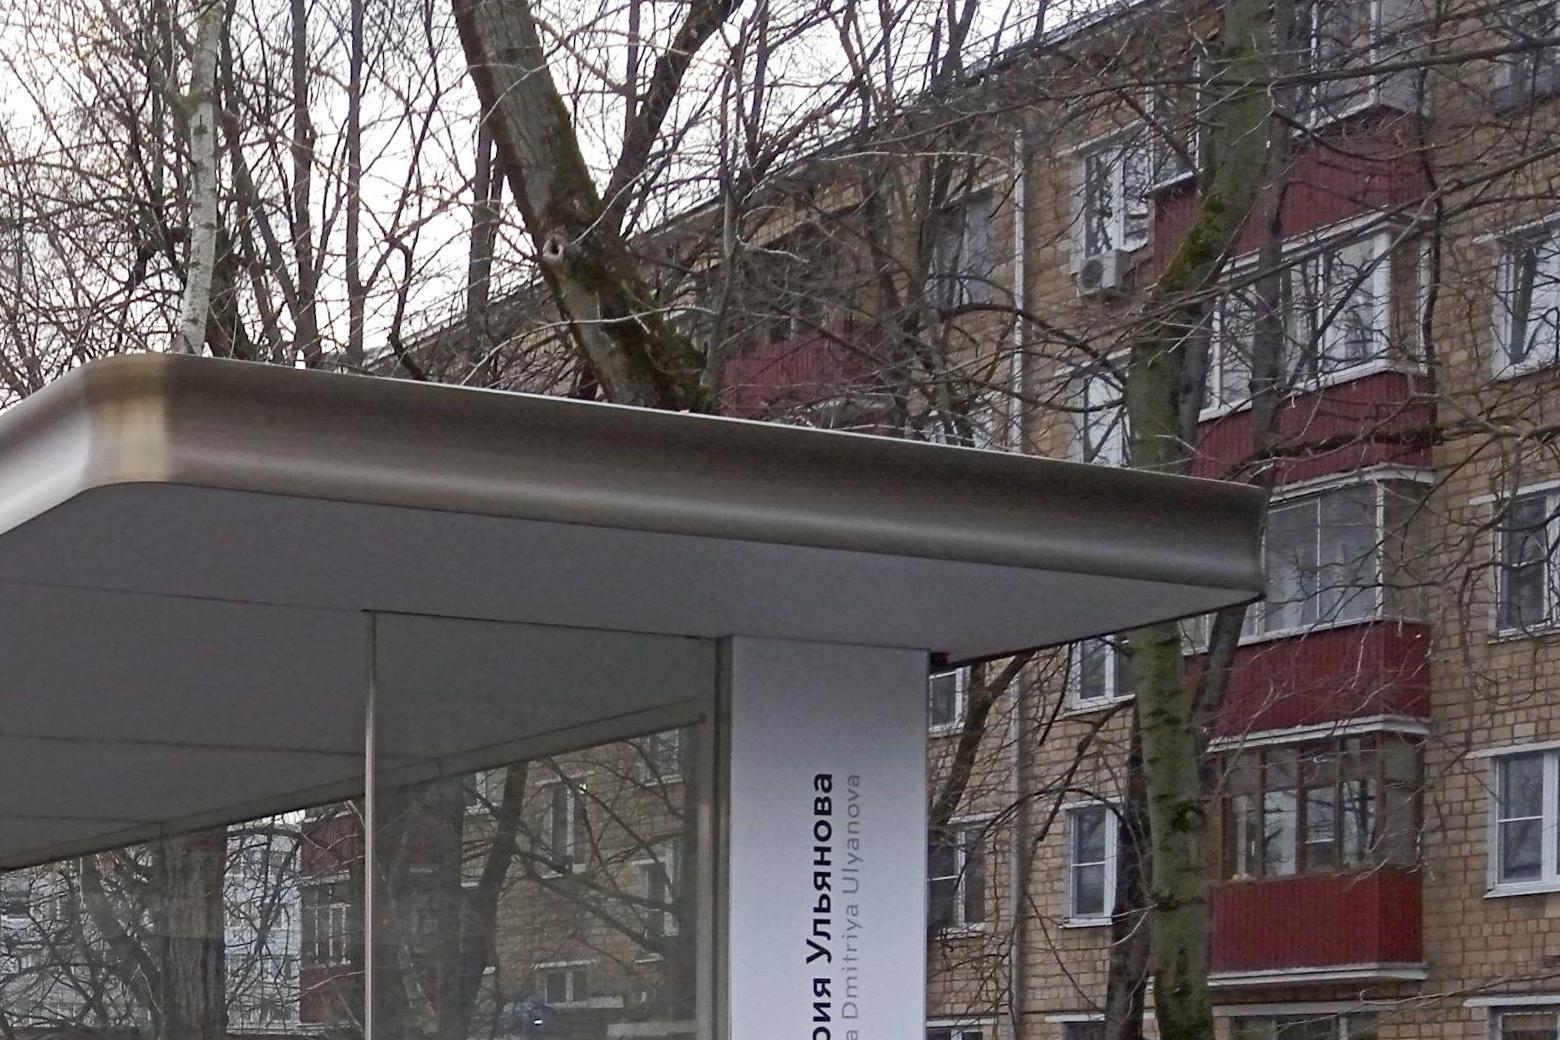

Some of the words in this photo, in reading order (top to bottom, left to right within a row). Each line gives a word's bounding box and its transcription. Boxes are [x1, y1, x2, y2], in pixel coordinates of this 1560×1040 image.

[805, 772, 834, 965] Ульянова
[841, 773, 865, 895] Ulyanova
[841, 903, 865, 1020] Dmitriya
